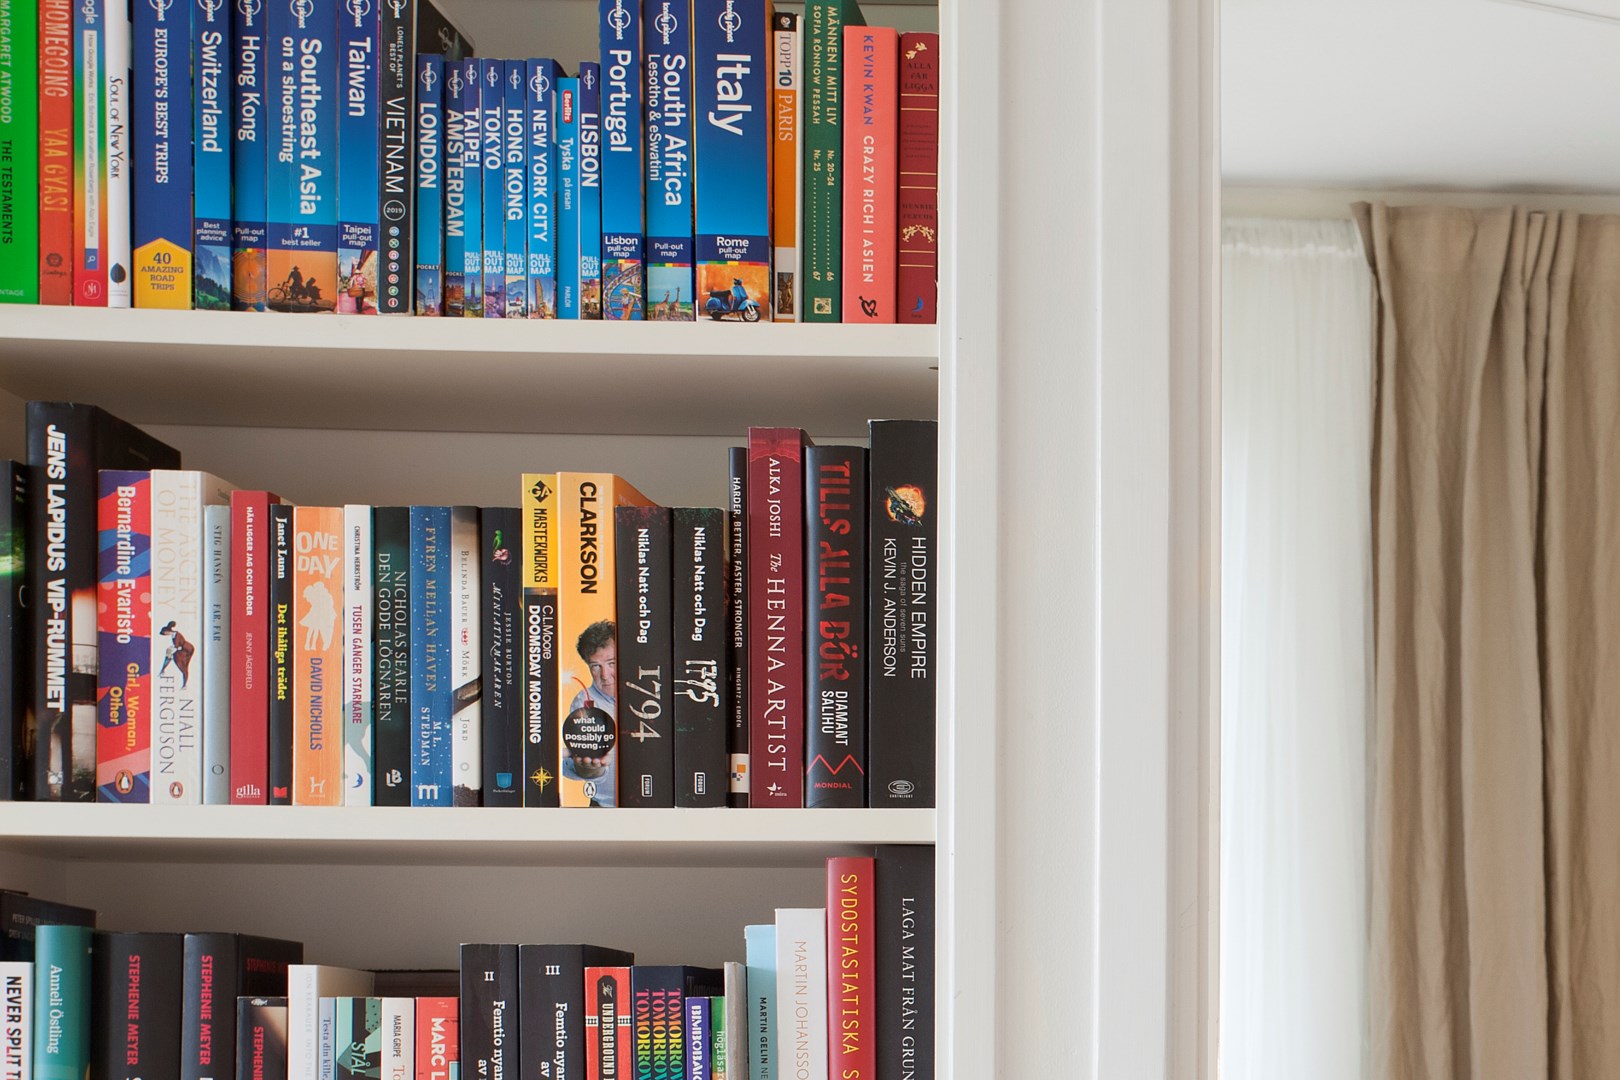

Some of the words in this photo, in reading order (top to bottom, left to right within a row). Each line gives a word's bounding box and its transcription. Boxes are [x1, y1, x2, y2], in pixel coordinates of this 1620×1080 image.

[826, 5, 839, 63] MÄNNEN
[863, 35, 874, 78] KEVIN
[155, 28, 168, 98] EUROPE'S
[238, 36, 261, 88] Hong
[349, 37, 372, 117] Taiwan
[202, 31, 223, 153] Switzerland
[300, 38, 323, 159] Southeast
[605, 50, 633, 152] Portugal
[664, 54, 687, 126] South
[709, 54, 752, 136] Italy
[826, 74, 837, 104] MITT
[863, 84, 874, 126] KWAN
[156, 101, 168, 138] BEST
[238, 93, 261, 142] Kong
[464, 108, 480, 168] TAIPEI
[533, 109, 548, 149] NEW
[779, 94, 793, 142] PARIS
[827, 106, 837, 126] LIV
[1, 140, 12, 162] THE
[44, 128, 68, 162] YAA
[156, 142, 169, 185] TRIPS
[386, 97, 406, 193] VIETNAM
[420, 103, 437, 188] LONDON
[863, 135, 874, 184] CRAZY
[44, 169, 68, 212] GYASI
[300, 164, 322, 215] Asia
[447, 109, 465, 237] AMSTERDAM
[533, 152, 548, 198] YORK
[664, 133, 688, 206] Africa
[2, 165, 13, 244] TESTAMENTS
[534, 203, 548, 243] CITY
[863, 189, 874, 226] RICH
[282, 238, 301, 247] best
[302, 239, 321, 248] seller
[294, 227, 308, 238] #1
[717, 237, 749, 246] Rome
[719, 245, 748, 255] pull-out
[141, 265, 183, 274] AMAZING
[150, 274, 174, 282] ROAD
[153, 252, 171, 265] 40
[863, 239, 874, 284] ASIEN
[151, 282, 174, 291] TRIPS
[47, 424, 66, 480] JENS
[767, 457, 782, 495] ALKA
[732, 477, 742, 517] HARDER,
[766, 498, 782, 537] JOSHI
[47, 485, 66, 573] LAPIDUS
[117, 485, 136, 575] Bernardine
[296, 531, 339, 554] ONE
[579, 482, 598, 594] CLARKSON
[733, 520, 743, 555] BETTER,
[297, 556, 340, 579] DAY
[734, 557, 744, 593] FASTER,
[769, 552, 781, 572] The
[883, 538, 897, 578] KEVIN
[911, 537, 927, 606] HIDDEN
[117, 581, 136, 645] Evaristo
[353, 606, 363, 635] TUSEN
[394, 571, 407, 646] NICHOLAS
[734, 595, 744, 649] STRONGER
[767, 577, 786, 672] HENNA
[47, 579, 65, 712] VIP-RUMMET
[353, 637, 365, 672] GÅNGER
[528, 605, 542, 676] DOOMSDAY
[883, 598, 898, 677] ANDERSON
[911, 611, 928, 680] EMPIRE
[310, 658, 323, 692] DAVID
[394, 648, 407, 704] SEARLE
[353, 674, 363, 725] STARKARE
[529, 681, 543, 744] MORNING
[573, 717, 597, 726] what
[820, 690, 835, 734] SALIHU
[835, 690, 849, 747] DIAMANT
[158, 675, 175, 775] FERGUSON
[179, 698, 194, 752] NIALL
[310, 697, 323, 751] NICHOLLS
[565, 732, 602, 744] possibly
[603, 733, 615, 743] go
[581, 724, 607, 733] could
[763, 679, 786, 771] ARTIST
[901, 898, 916, 940] LAGA
[49, 964, 63, 1004] Anneli
[840, 874, 861, 1056] SYDOSTASIATISKA
[902, 946, 916, 978] MAT
[6, 975, 23, 1024] NEVER
[128, 954, 142, 1019] STEPHENIE
[902, 986, 919, 1034] FRÅN
[6, 1028, 22, 1065] SPLIT
[46, 1007, 64, 1055] Östling
[128, 1023, 140, 1066] MEYER
[393, 1014, 401, 1036] MARIA
[393, 1037, 401, 1059] GRIPE
[430, 1017, 446, 1067] MARC
[602, 1002, 616, 1076] UNDERGROUND
